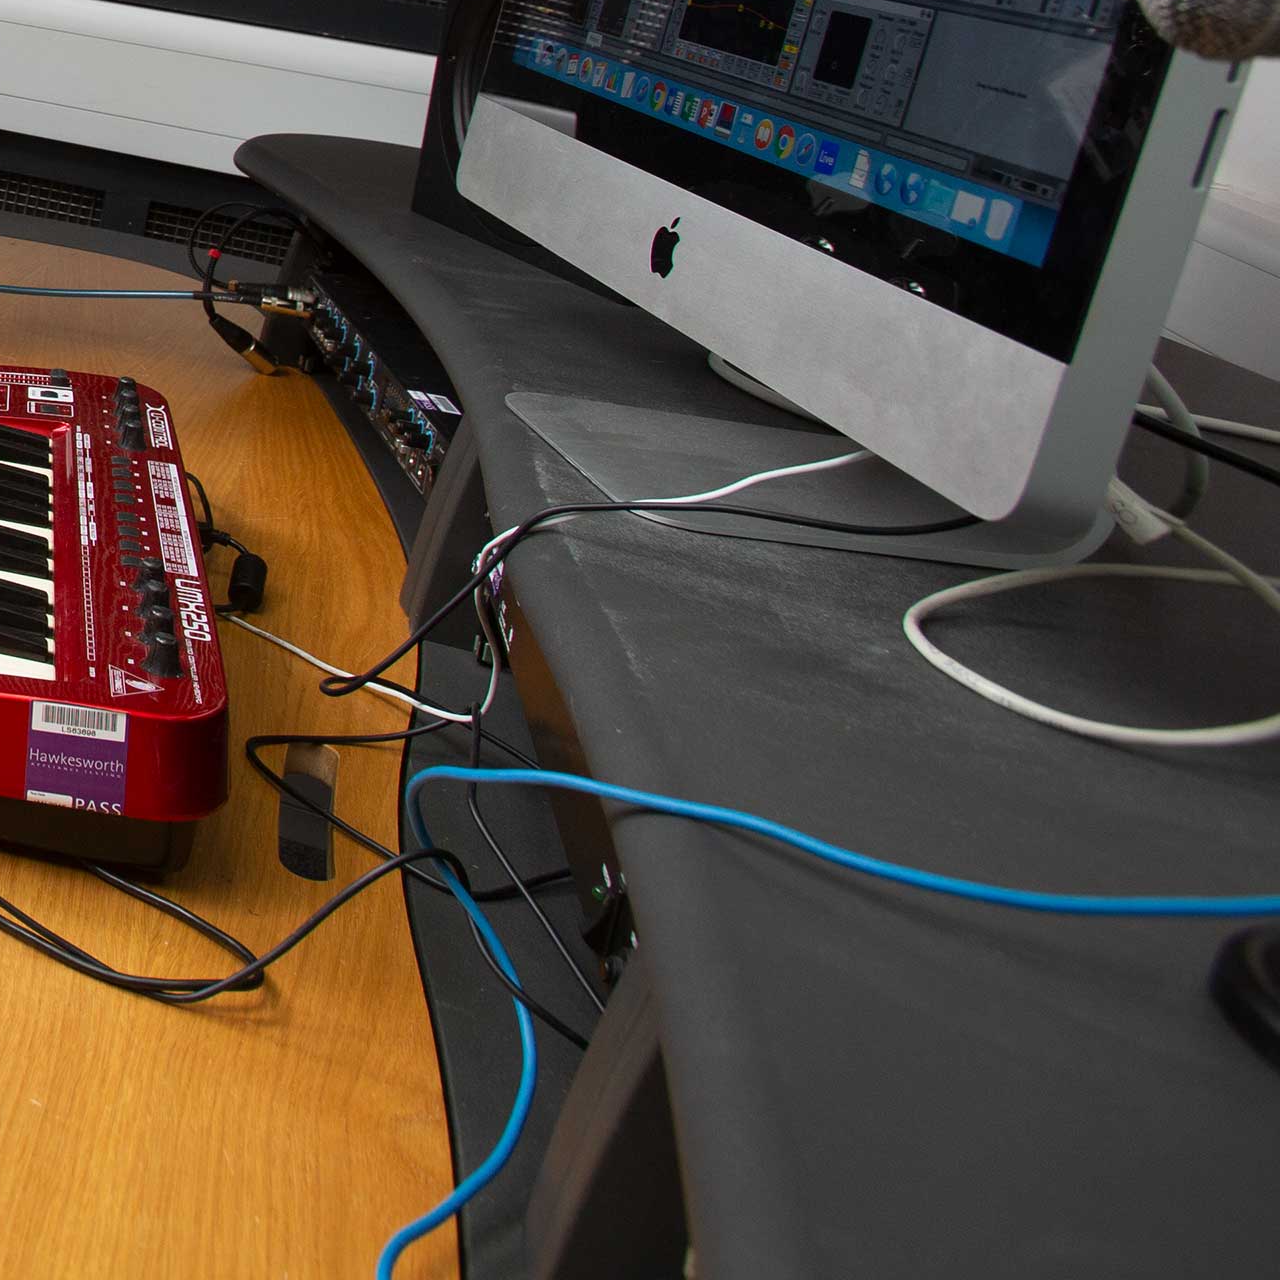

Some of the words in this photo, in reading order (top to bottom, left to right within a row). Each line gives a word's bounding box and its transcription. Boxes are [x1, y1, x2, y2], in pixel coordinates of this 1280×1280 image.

[175, 578, 212, 642] UMX250
[29, 747, 124, 773] Hawkesworth
[75, 798, 121, 816] PASS
